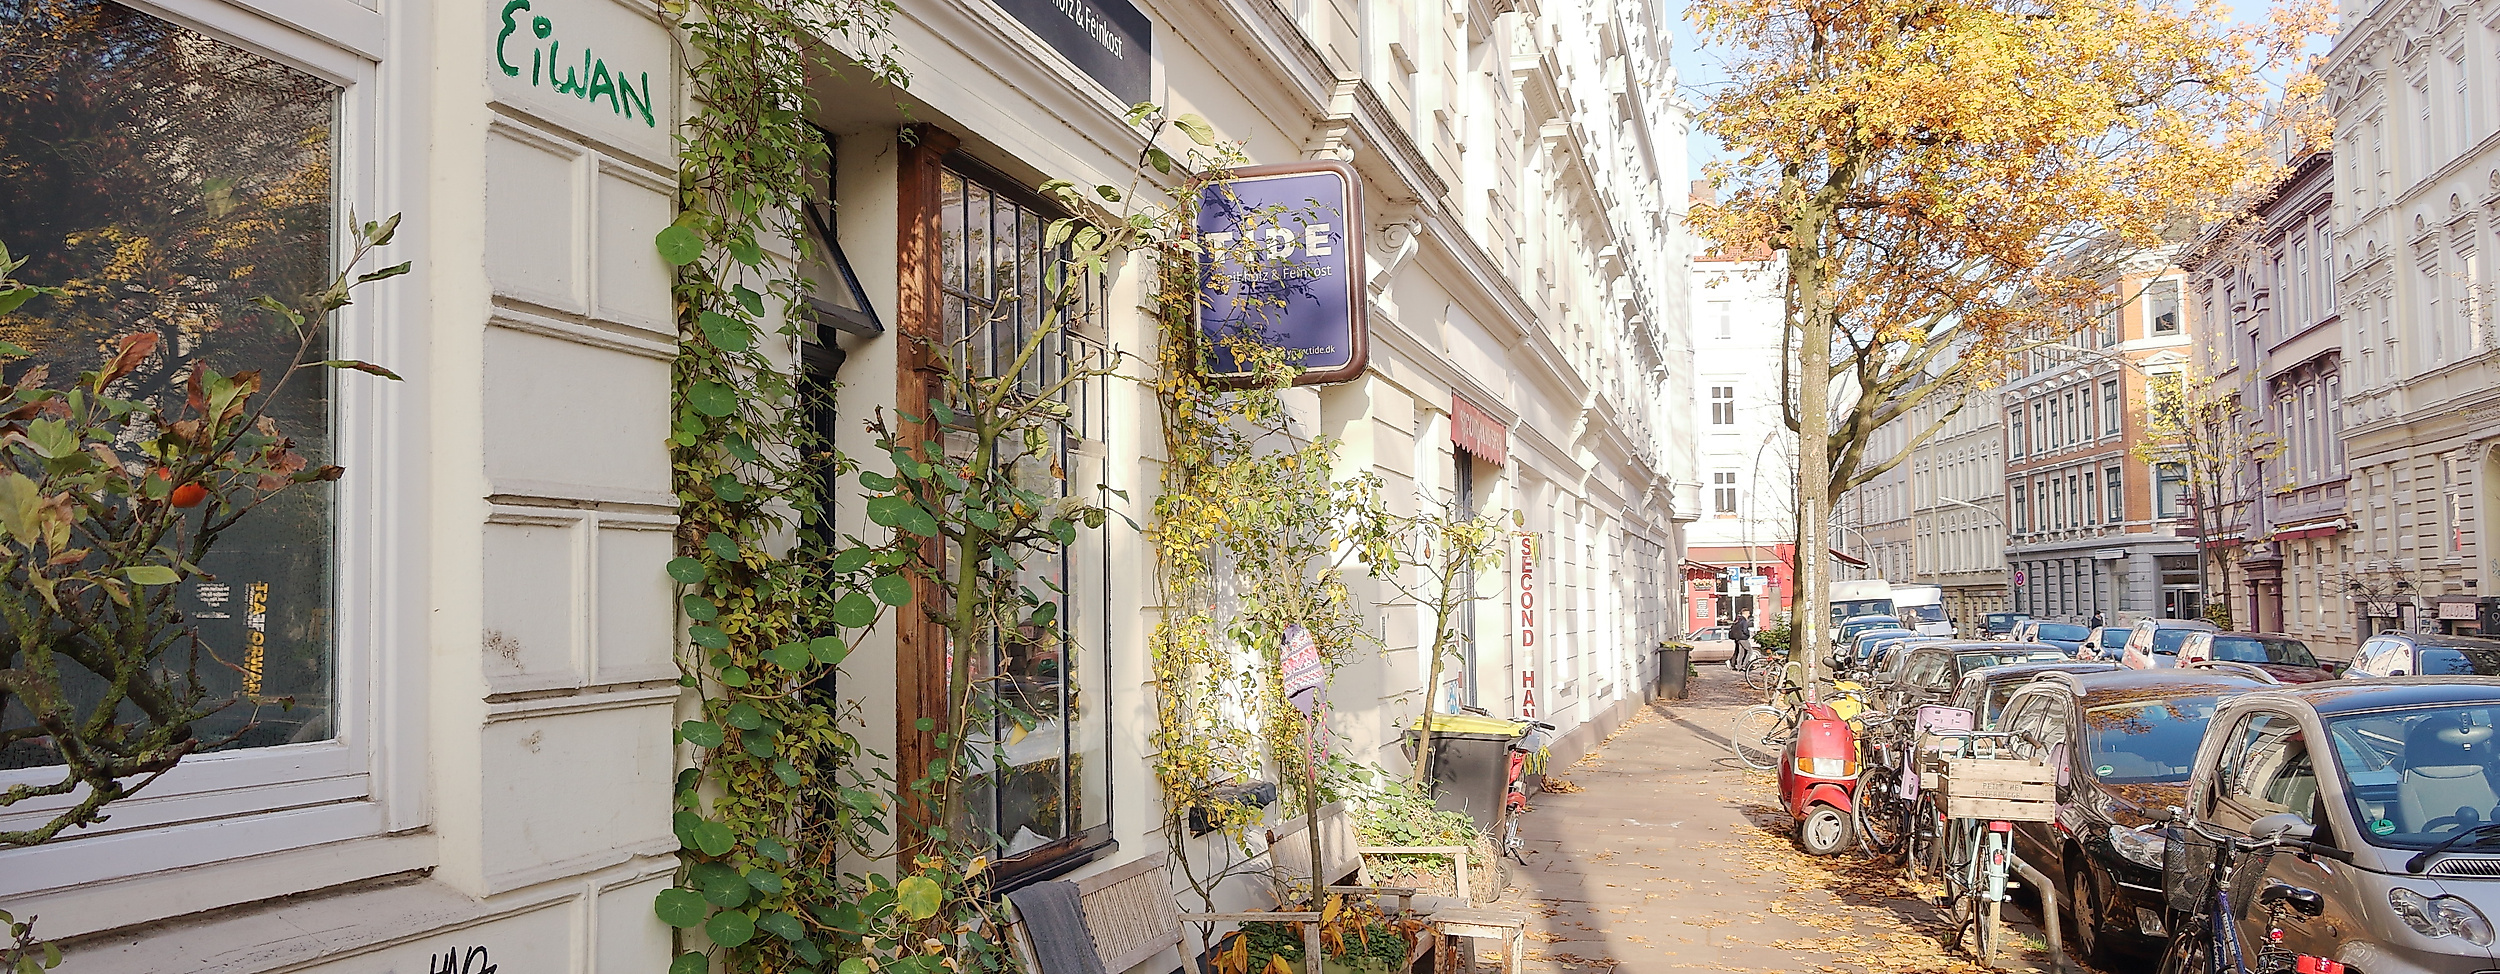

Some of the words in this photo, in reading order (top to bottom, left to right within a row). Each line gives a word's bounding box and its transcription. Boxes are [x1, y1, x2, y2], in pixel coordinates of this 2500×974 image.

[1085, 6, 1124, 60] Feinkost
[1205, 223, 1332, 263] TIDE
[1283, 265, 1332, 279] Feinost
[1520, 538, 1534, 647] SECOND
